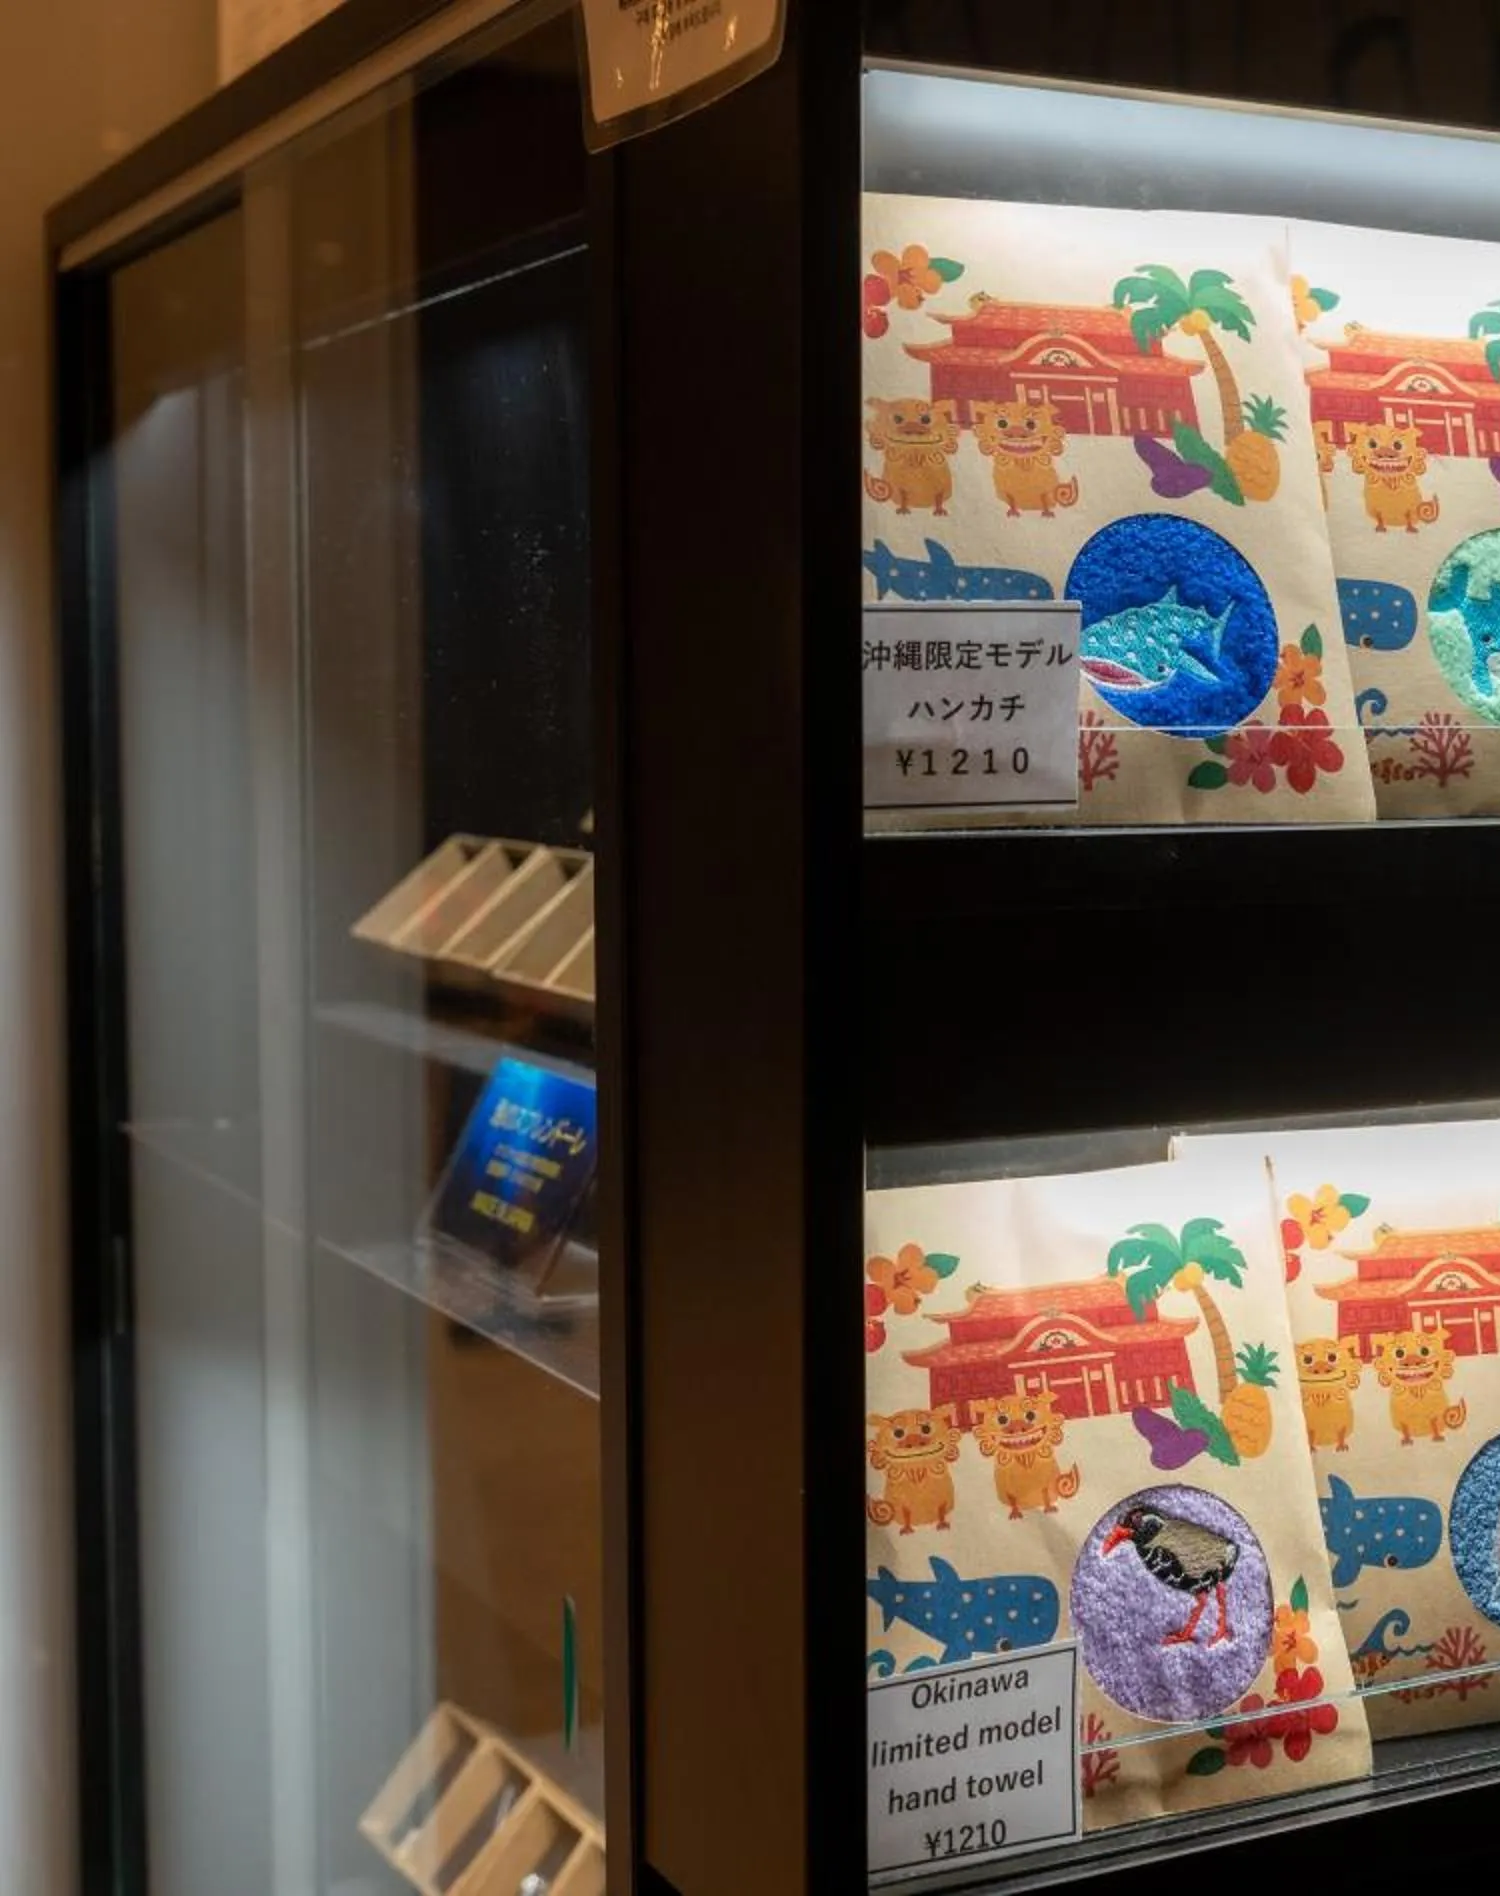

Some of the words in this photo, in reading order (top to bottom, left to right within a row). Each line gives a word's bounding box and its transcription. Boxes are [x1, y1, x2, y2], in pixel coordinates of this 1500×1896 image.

[862, 639, 1073, 672] 沖縄限定モデル
[907, 693, 1025, 722] ハンカチ
[895, 747, 1029, 776] ¥1210
[911, 1668, 1029, 1710] Okinawa
[871, 1723, 969, 1768] limited
[978, 1706, 1061, 1746] model
[888, 1776, 957, 1814] hand
[966, 1760, 1043, 1799] towel
[925, 1818, 1007, 1857] ¥1210
